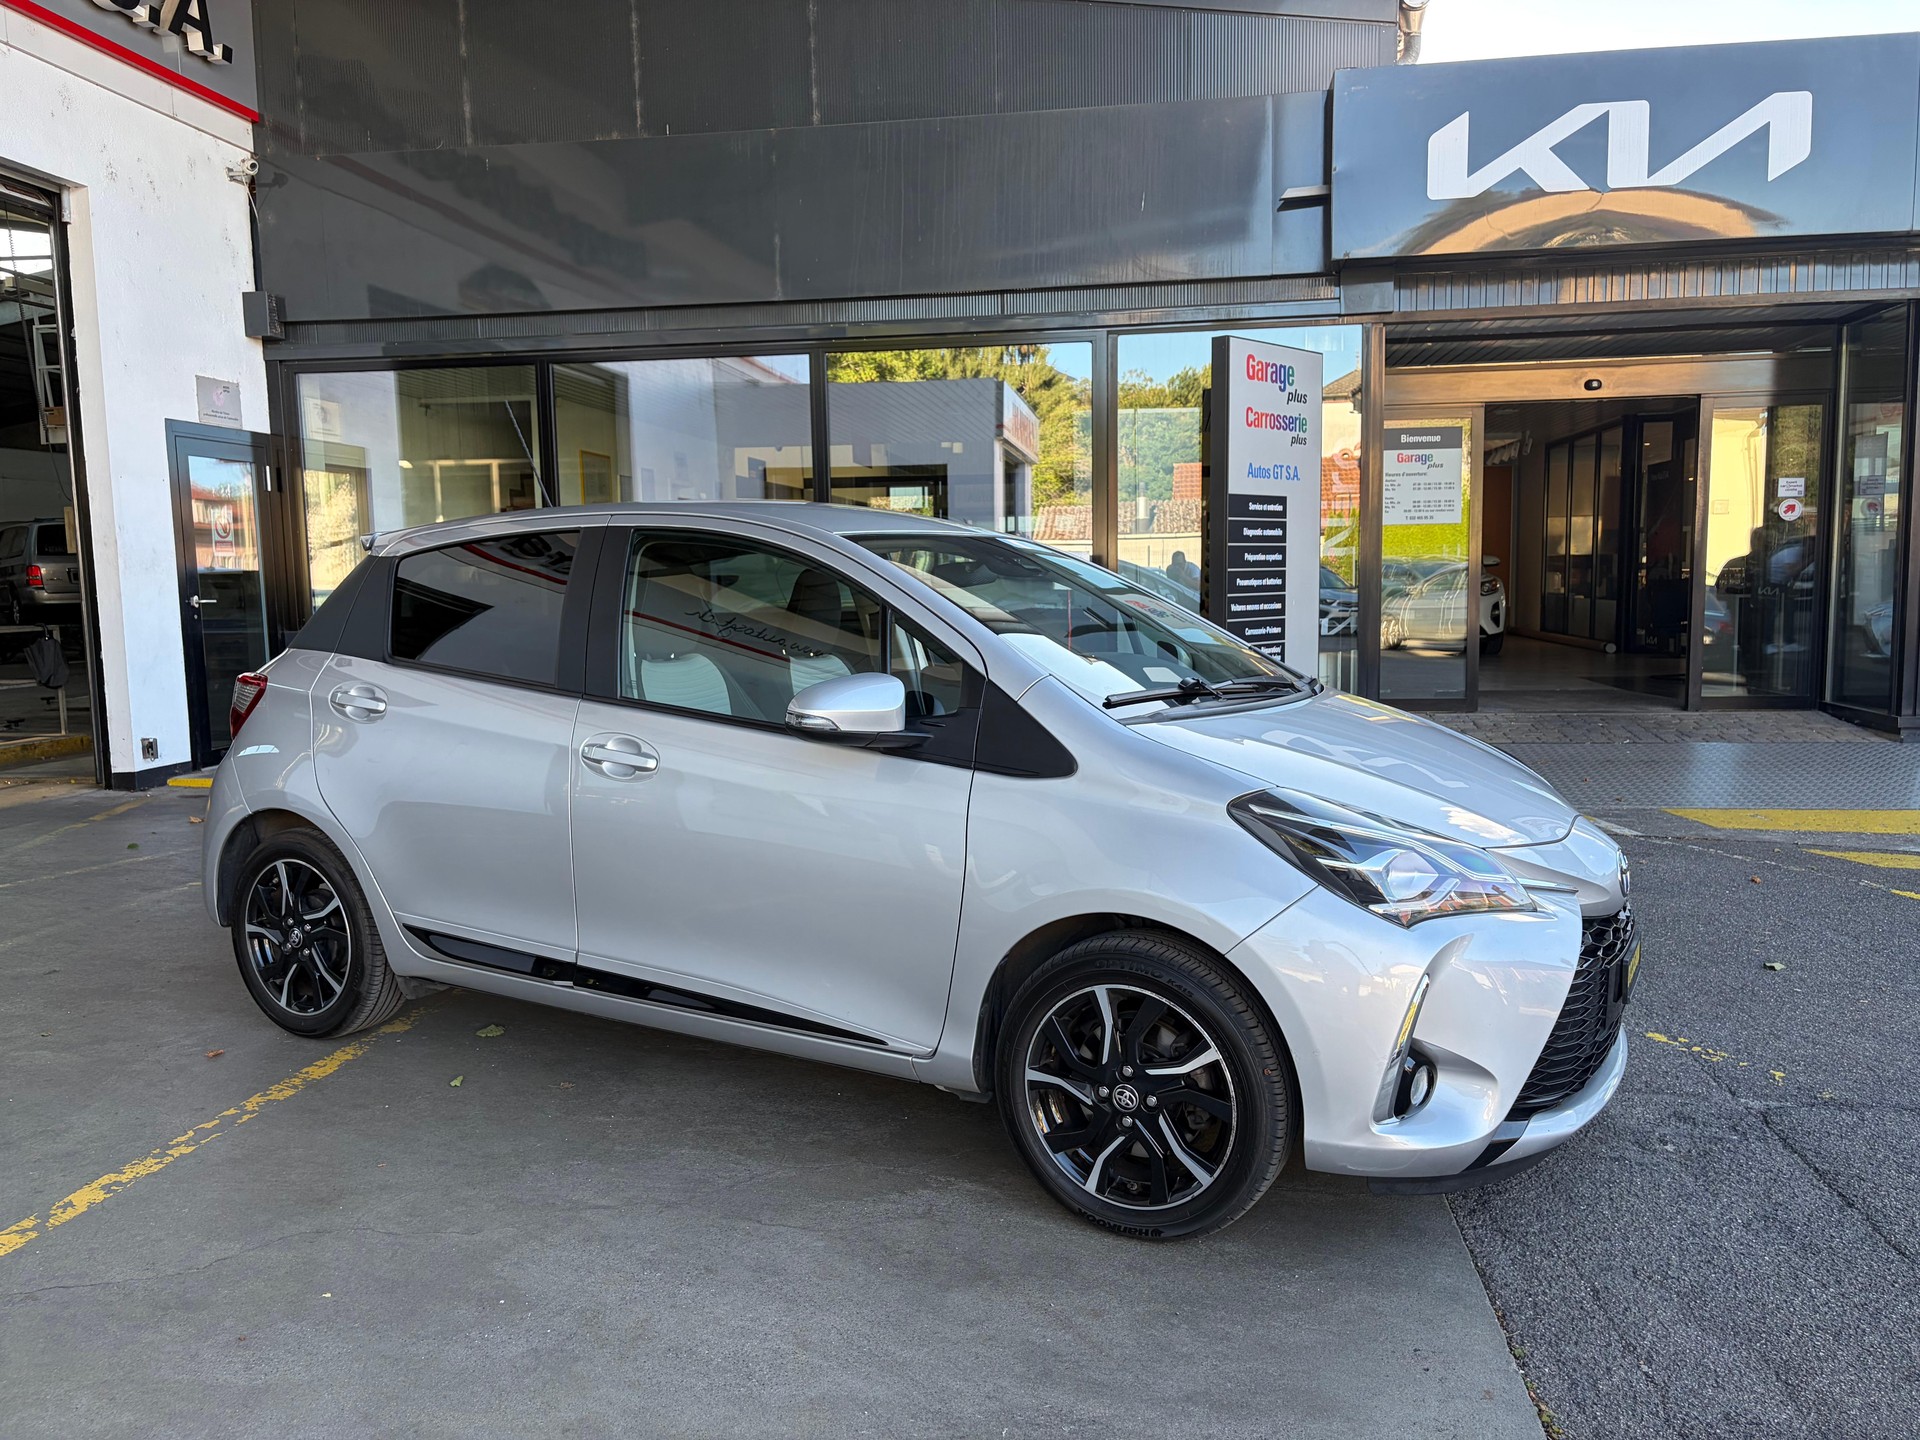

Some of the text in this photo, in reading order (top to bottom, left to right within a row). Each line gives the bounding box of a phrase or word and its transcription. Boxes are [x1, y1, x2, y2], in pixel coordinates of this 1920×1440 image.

[92, 0, 233, 64] .A.
[1427, 91, 1813, 200] KIA
[1246, 354, 1295, 392] Garage
[1286, 389, 1308, 405] plus
[1245, 407, 1308, 434] Carrosserie
[1290, 434, 1307, 447] plus
[1400, 434, 1441, 443] Bienvenue
[1397, 452, 1434, 465] Garage
[1247, 462, 1301, 481] Autos GT S.A.
[1427, 461, 1444, 470] plus
[1248, 502, 1263, 511] Service
[1243, 527, 1283, 537] Diagnostic automobile
[1244, 552, 1266, 562] Préparation
[1236, 578, 1263, 587] Pneumatiques
[1231, 603, 1247, 611] Voitures
[1264, 602, 1282, 610] occasions
